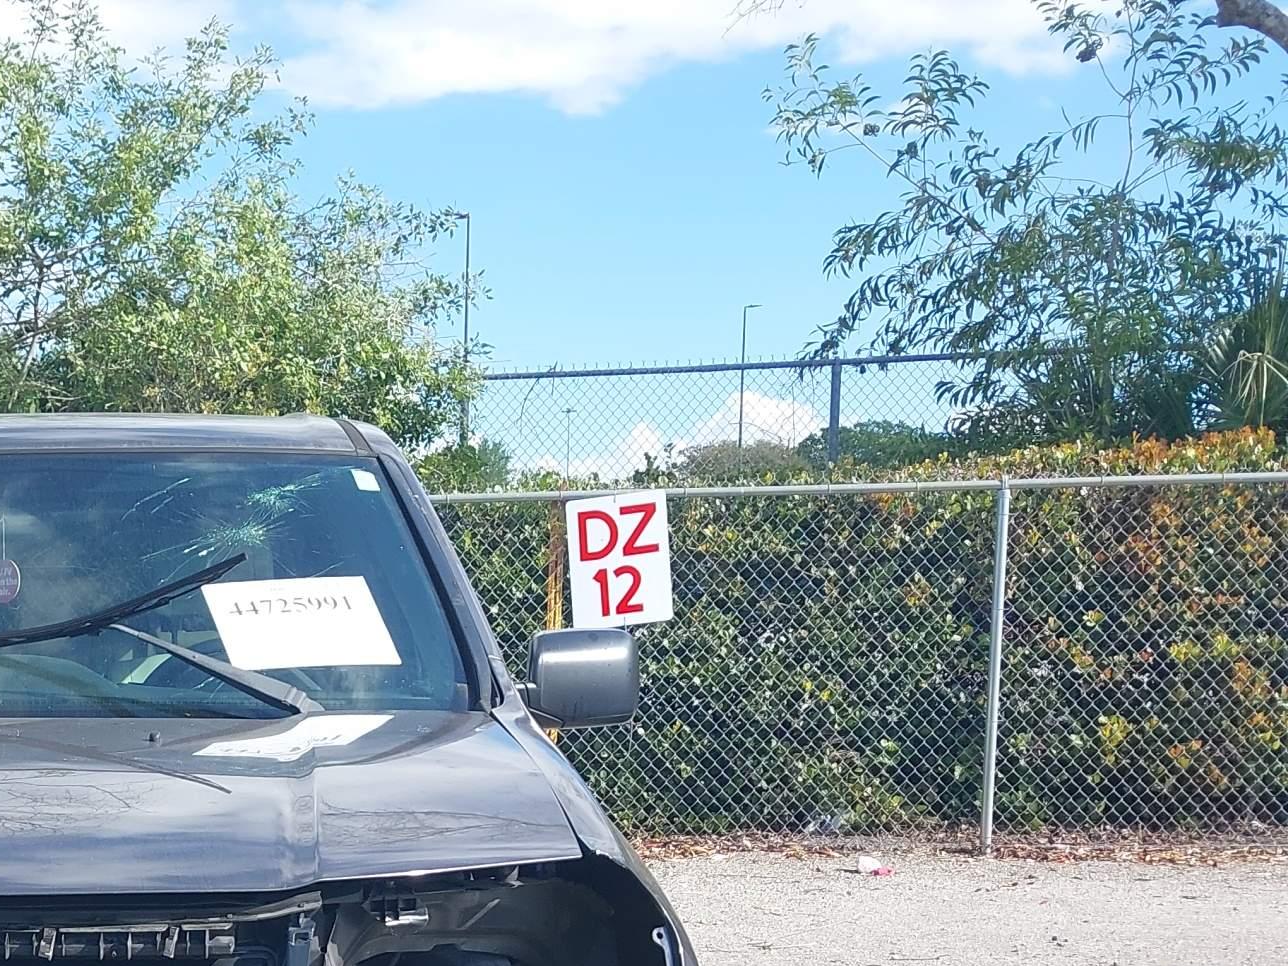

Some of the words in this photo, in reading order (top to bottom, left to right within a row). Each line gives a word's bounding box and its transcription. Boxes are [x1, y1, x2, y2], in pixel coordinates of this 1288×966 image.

[576, 501, 660, 562] DZ
[229, 595, 352, 616] 44725991
[592, 564, 645, 618] 12
